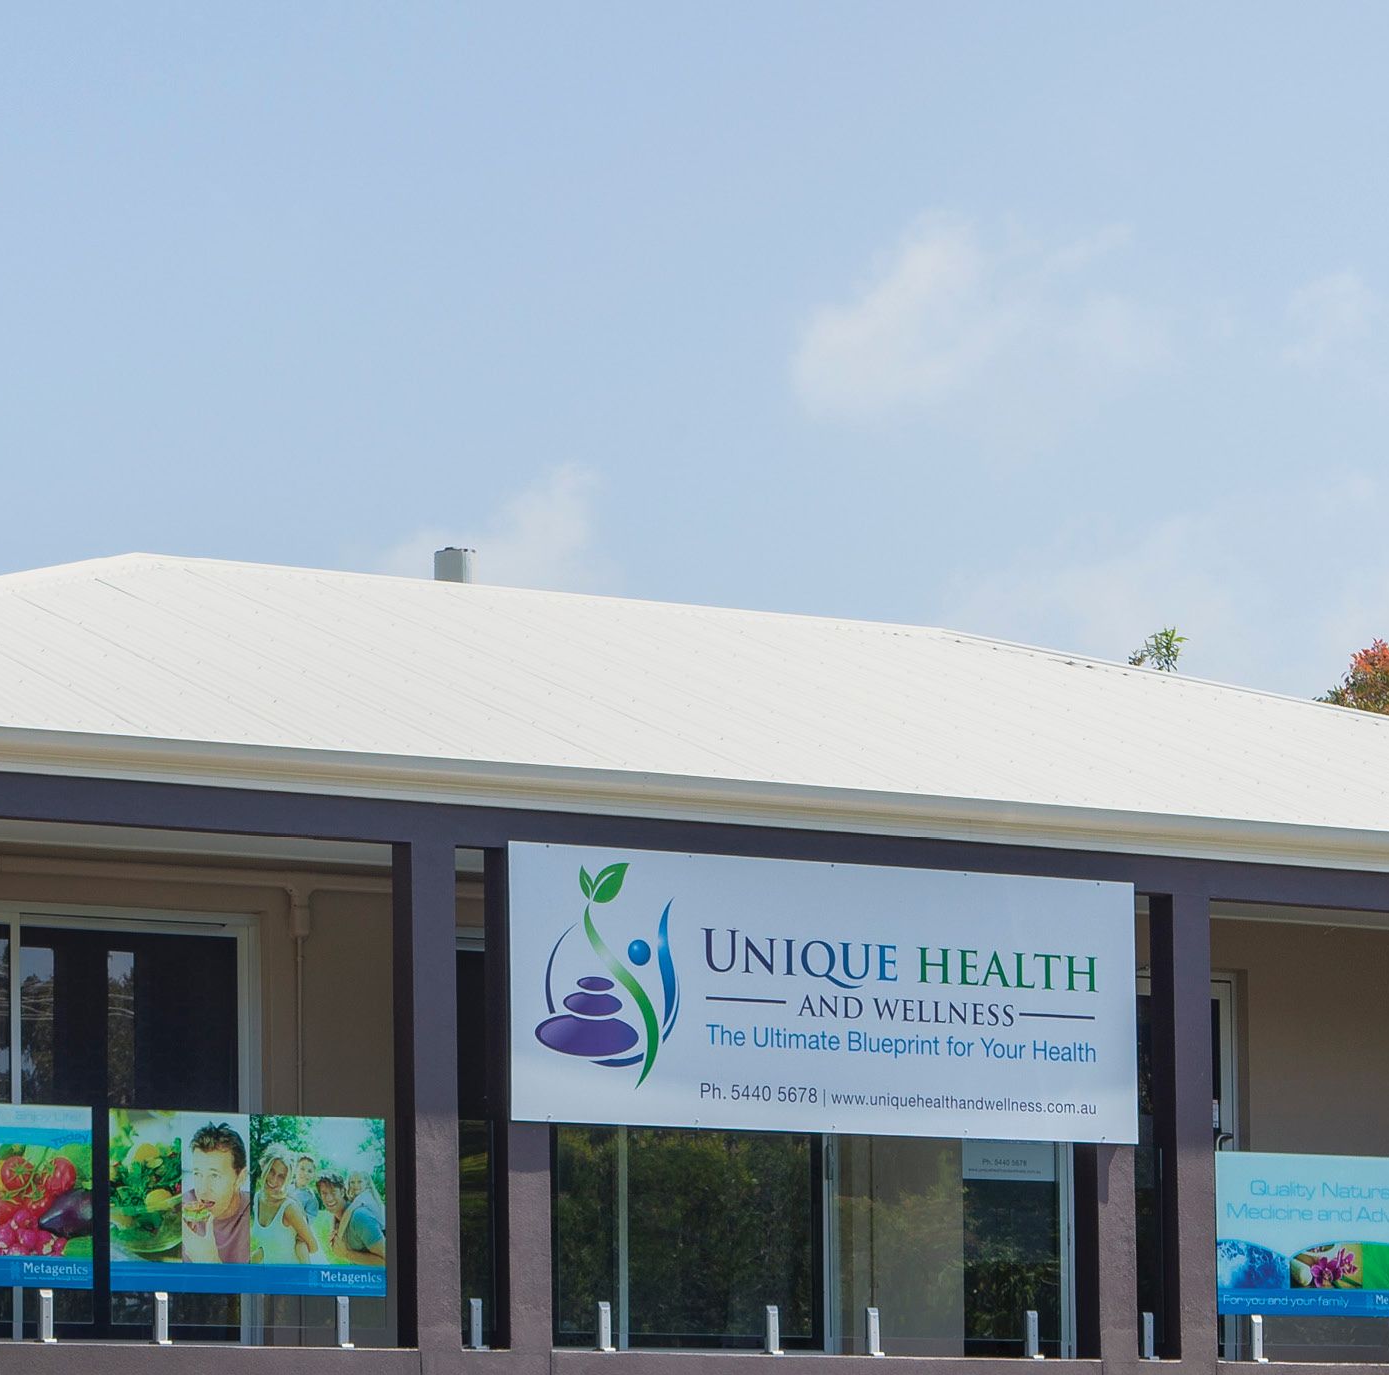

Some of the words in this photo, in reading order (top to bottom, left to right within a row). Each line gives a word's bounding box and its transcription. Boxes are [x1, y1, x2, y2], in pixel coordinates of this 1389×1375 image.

[701, 927, 898, 989] UNIQUE
[916, 947, 1099, 993] HEALTH
[798, 994, 863, 1019] AND
[873, 997, 1014, 1027] WELLNESS
[706, 1024, 745, 1046] The
[753, 1027, 840, 1051] Ultimate
[848, 1031, 939, 1059] Blueprint
[947, 1036, 974, 1057] for
[980, 1038, 1026, 1059] Your
[1033, 1041, 1097, 1063] Health
[700, 1082, 726, 1100] Ph.
[731, 1084, 771, 1103] 5440
[777, 1086, 817, 1104] 5678
[831, 1092, 1097, 1116] www.uniquehealthandwellness.com.au
[1250, 1179, 1316, 1200] Quality
[1226, 1203, 1313, 1221] Medicine
[1318, 1207, 1352, 1222] and
[23, 1262, 88, 1276] Metagenics
[321, 1270, 382, 1284] Metagenics
[1223, 1295, 1245, 1305] For
[1246, 1297, 1265, 1307] you
[1268, 1295, 1288, 1305] and
[1290, 1297, 1316, 1308] your
[1317, 1296, 1349, 1308] family
